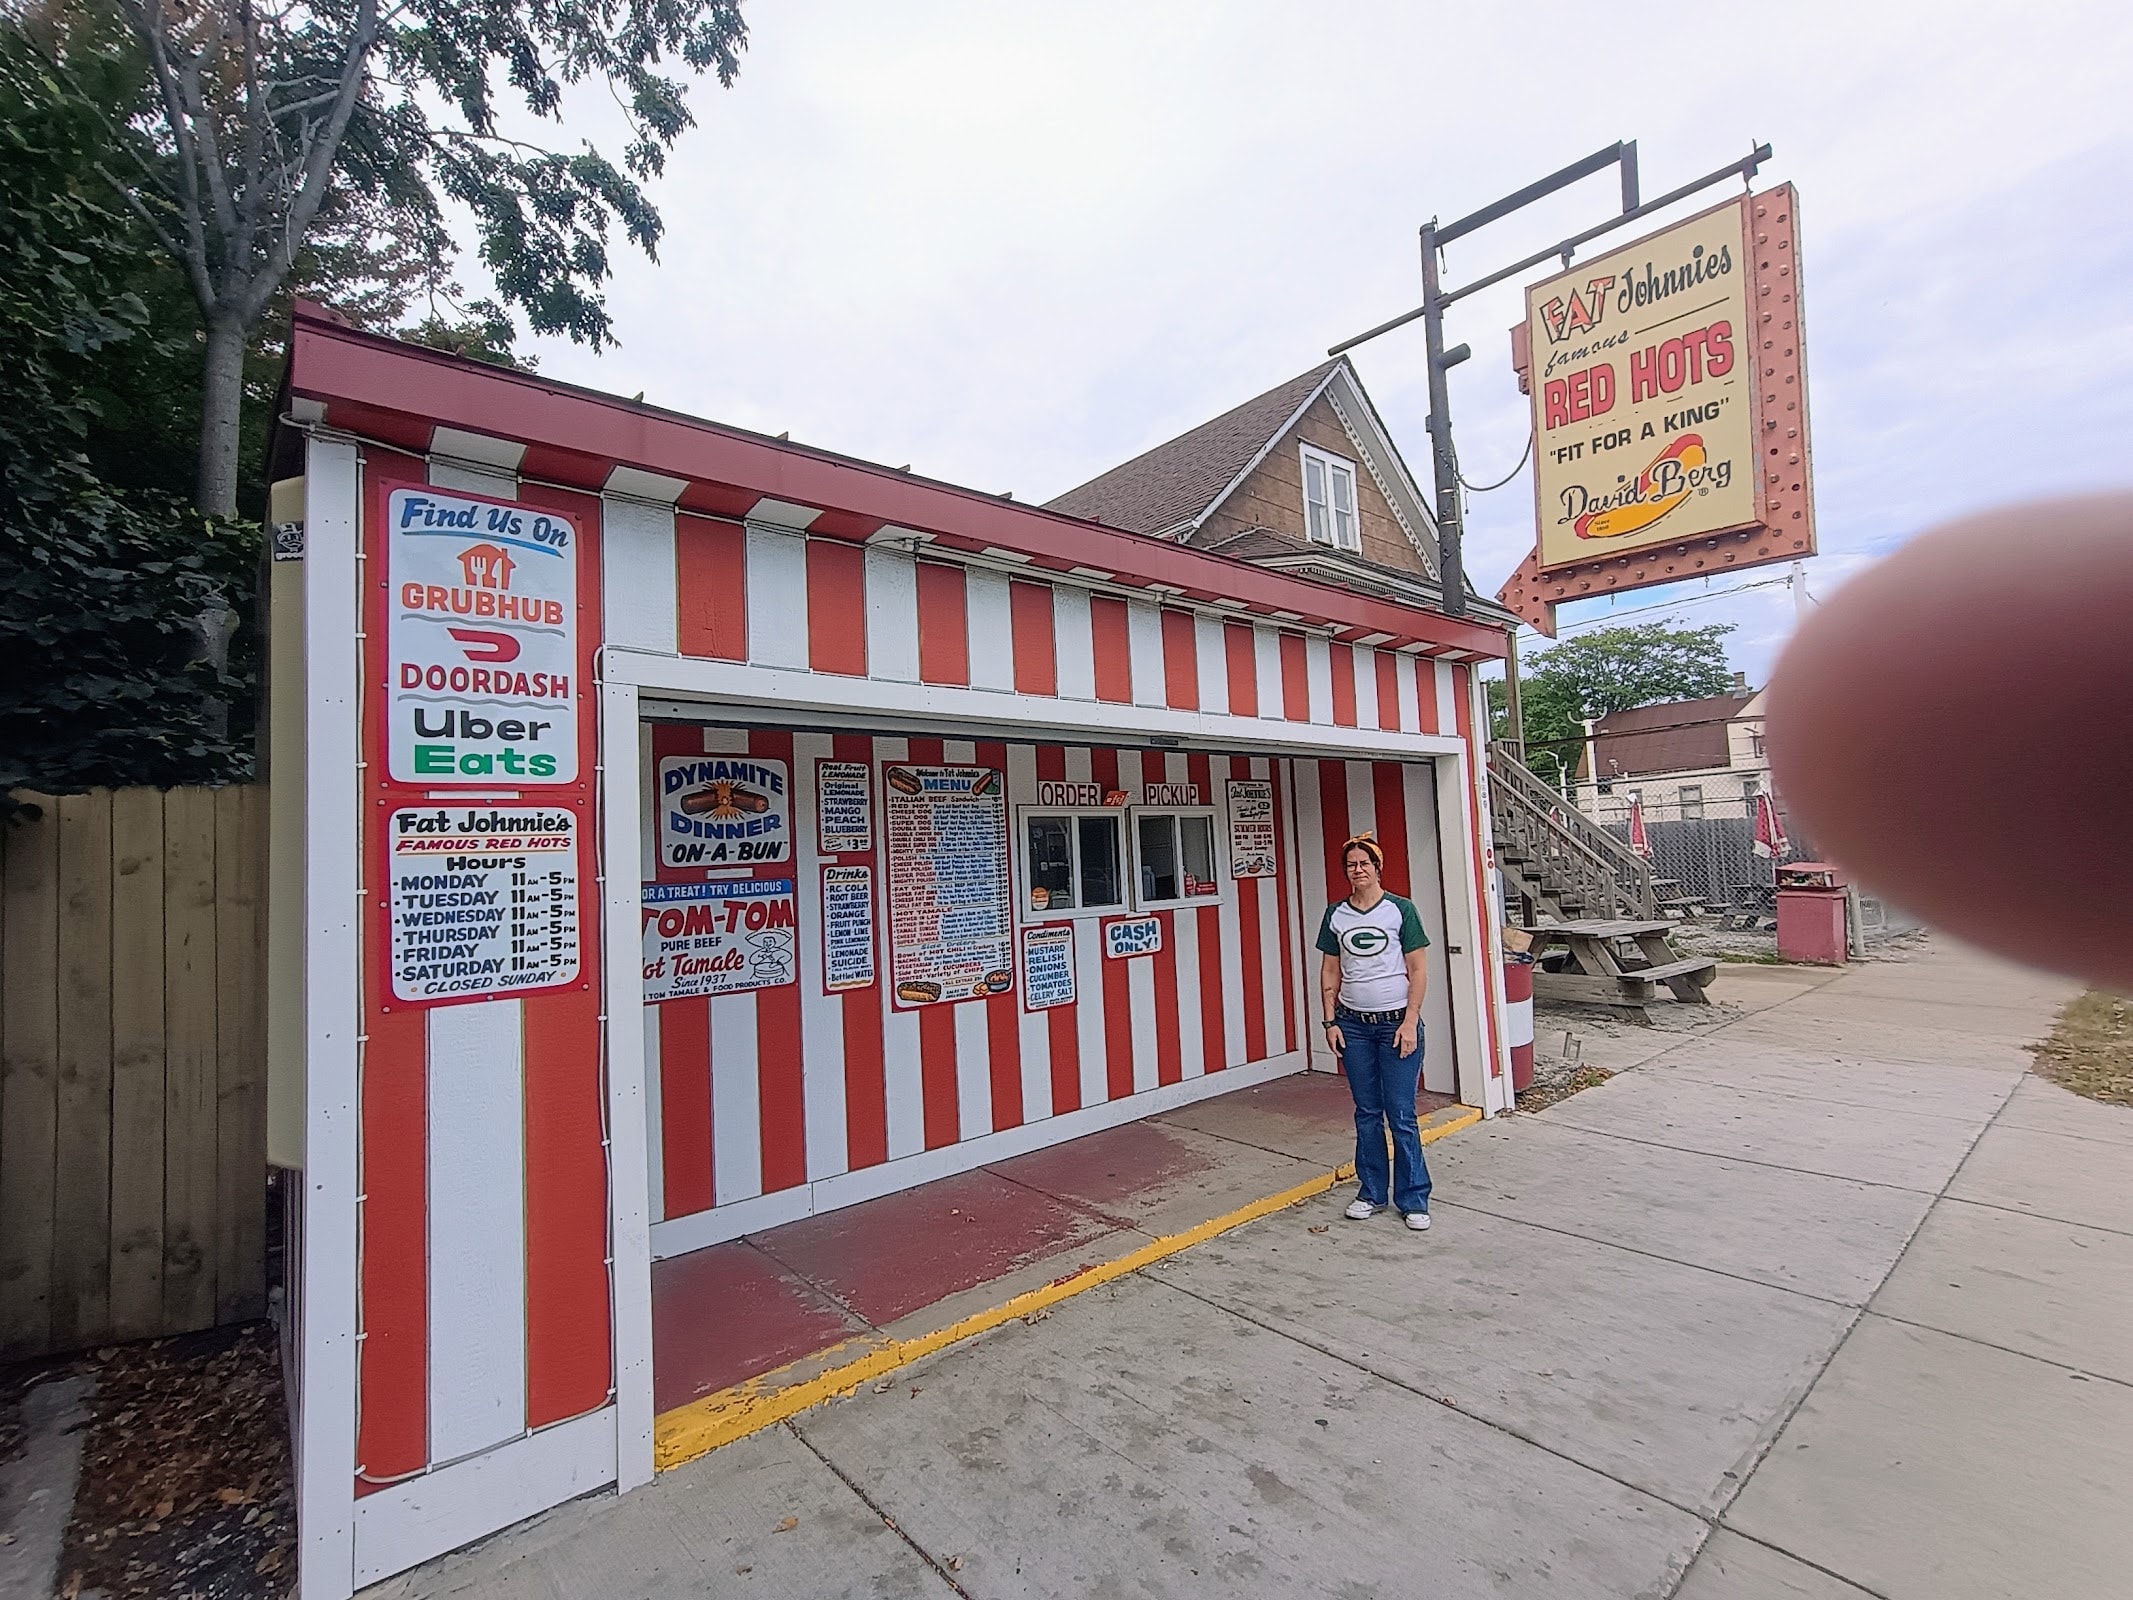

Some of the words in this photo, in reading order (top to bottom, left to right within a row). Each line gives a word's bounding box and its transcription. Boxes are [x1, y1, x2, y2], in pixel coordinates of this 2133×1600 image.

[1540, 275, 1616, 344] FAT
[1618, 244, 1732, 314] Johnnies
[1544, 330, 1629, 377] famous
[1544, 368, 1616, 431] RED
[1631, 320, 1735, 404] HOTS
[1550, 442, 1584, 465] "FIT
[1592, 428, 1631, 454] FOR
[1640, 421, 1656, 440] A
[1664, 397, 1730, 434] KING"
[1557, 474, 1647, 525] David
[1650, 459, 1732, 503] Berg
[401, 497, 479, 530] Find
[487, 508, 523, 535] Us
[532, 517, 569, 549] On
[401, 582, 565, 625] GRUBHUB
[400, 662, 569, 699] DOORDASH
[414, 707, 552, 741] Uber
[414, 744, 558, 777] Eats
[821, 763, 842, 771] Real
[665, 761, 783, 796] DYNAMITE
[821, 771, 867, 779] LEMONADE
[924, 779, 971, 791] MENU
[824, 798, 869, 806] STRAWBERRY
[1041, 782, 1098, 806] ORDER
[1148, 785, 1197, 806] PICKUP
[824, 807, 861, 815] MANGO
[396, 810, 452, 834] Fat
[457, 810, 572, 834] Johnnie's
[671, 811, 782, 839] DINNER
[825, 816, 865, 824] PEACH
[825, 825, 868, 833] BLUEBERRY
[395, 838, 480, 852] FAMOUS
[485, 838, 522, 849] RED
[527, 837, 572, 848] HOTS
[446, 856, 527, 872] Hours
[401, 874, 489, 891] MONDAY
[826, 869, 868, 880] Drinks
[658, 887, 665, 899] A
[667, 885, 706, 898] TREAT!
[710, 885, 729, 895] TRY
[733, 881, 782, 895] DELICIOUS
[845, 884, 868, 892] COLA
[402, 891, 500, 909] TUESDAY
[830, 893, 849, 902] ROOT
[851, 893, 868, 901] BEER
[829, 901, 869, 911] STRAWBERRY
[402, 908, 506, 927] WEDNESDAY
[830, 910, 865, 920] ORANGE
[830, 920, 851, 929] FRUIT
[1110, 921, 1157, 941] CASH
[403, 925, 501, 945] THURSDAY
[1027, 928, 1070, 940] Condiments
[403, 943, 480, 962] FRIDAY
[661, 940, 690, 952] PURE
[695, 937, 722, 949] BEEF
[1028, 944, 1065, 956] MUSTARD
[1114, 937, 1158, 953] ONLY!
[831, 948, 868, 958] LEMONADE
[1028, 953, 1064, 965] RELISH
[402, 958, 506, 981] SATURDAY
[643, 957, 665, 980] ot
[671, 948, 744, 977] Tamale
[832, 957, 868, 968] SUICIDE
[1029, 961, 1067, 974] ONIONS
[424, 978, 493, 994] CLOSED
[497, 971, 557, 986] SUNDAY
[672, 976, 698, 989] Since
[700, 974, 727, 986] 1937
[1029, 971, 1069, 983] CUCUMBER
[648, 992, 666, 1001] TOM
[668, 987, 699, 997] TAMALE
[713, 983, 733, 992] FOOD
[735, 979, 770, 988] PRODUCTS
[1030, 979, 1072, 992] TOMATOES
[1030, 990, 1054, 1001] CELERY
[1057, 987, 1072, 996] SALT
